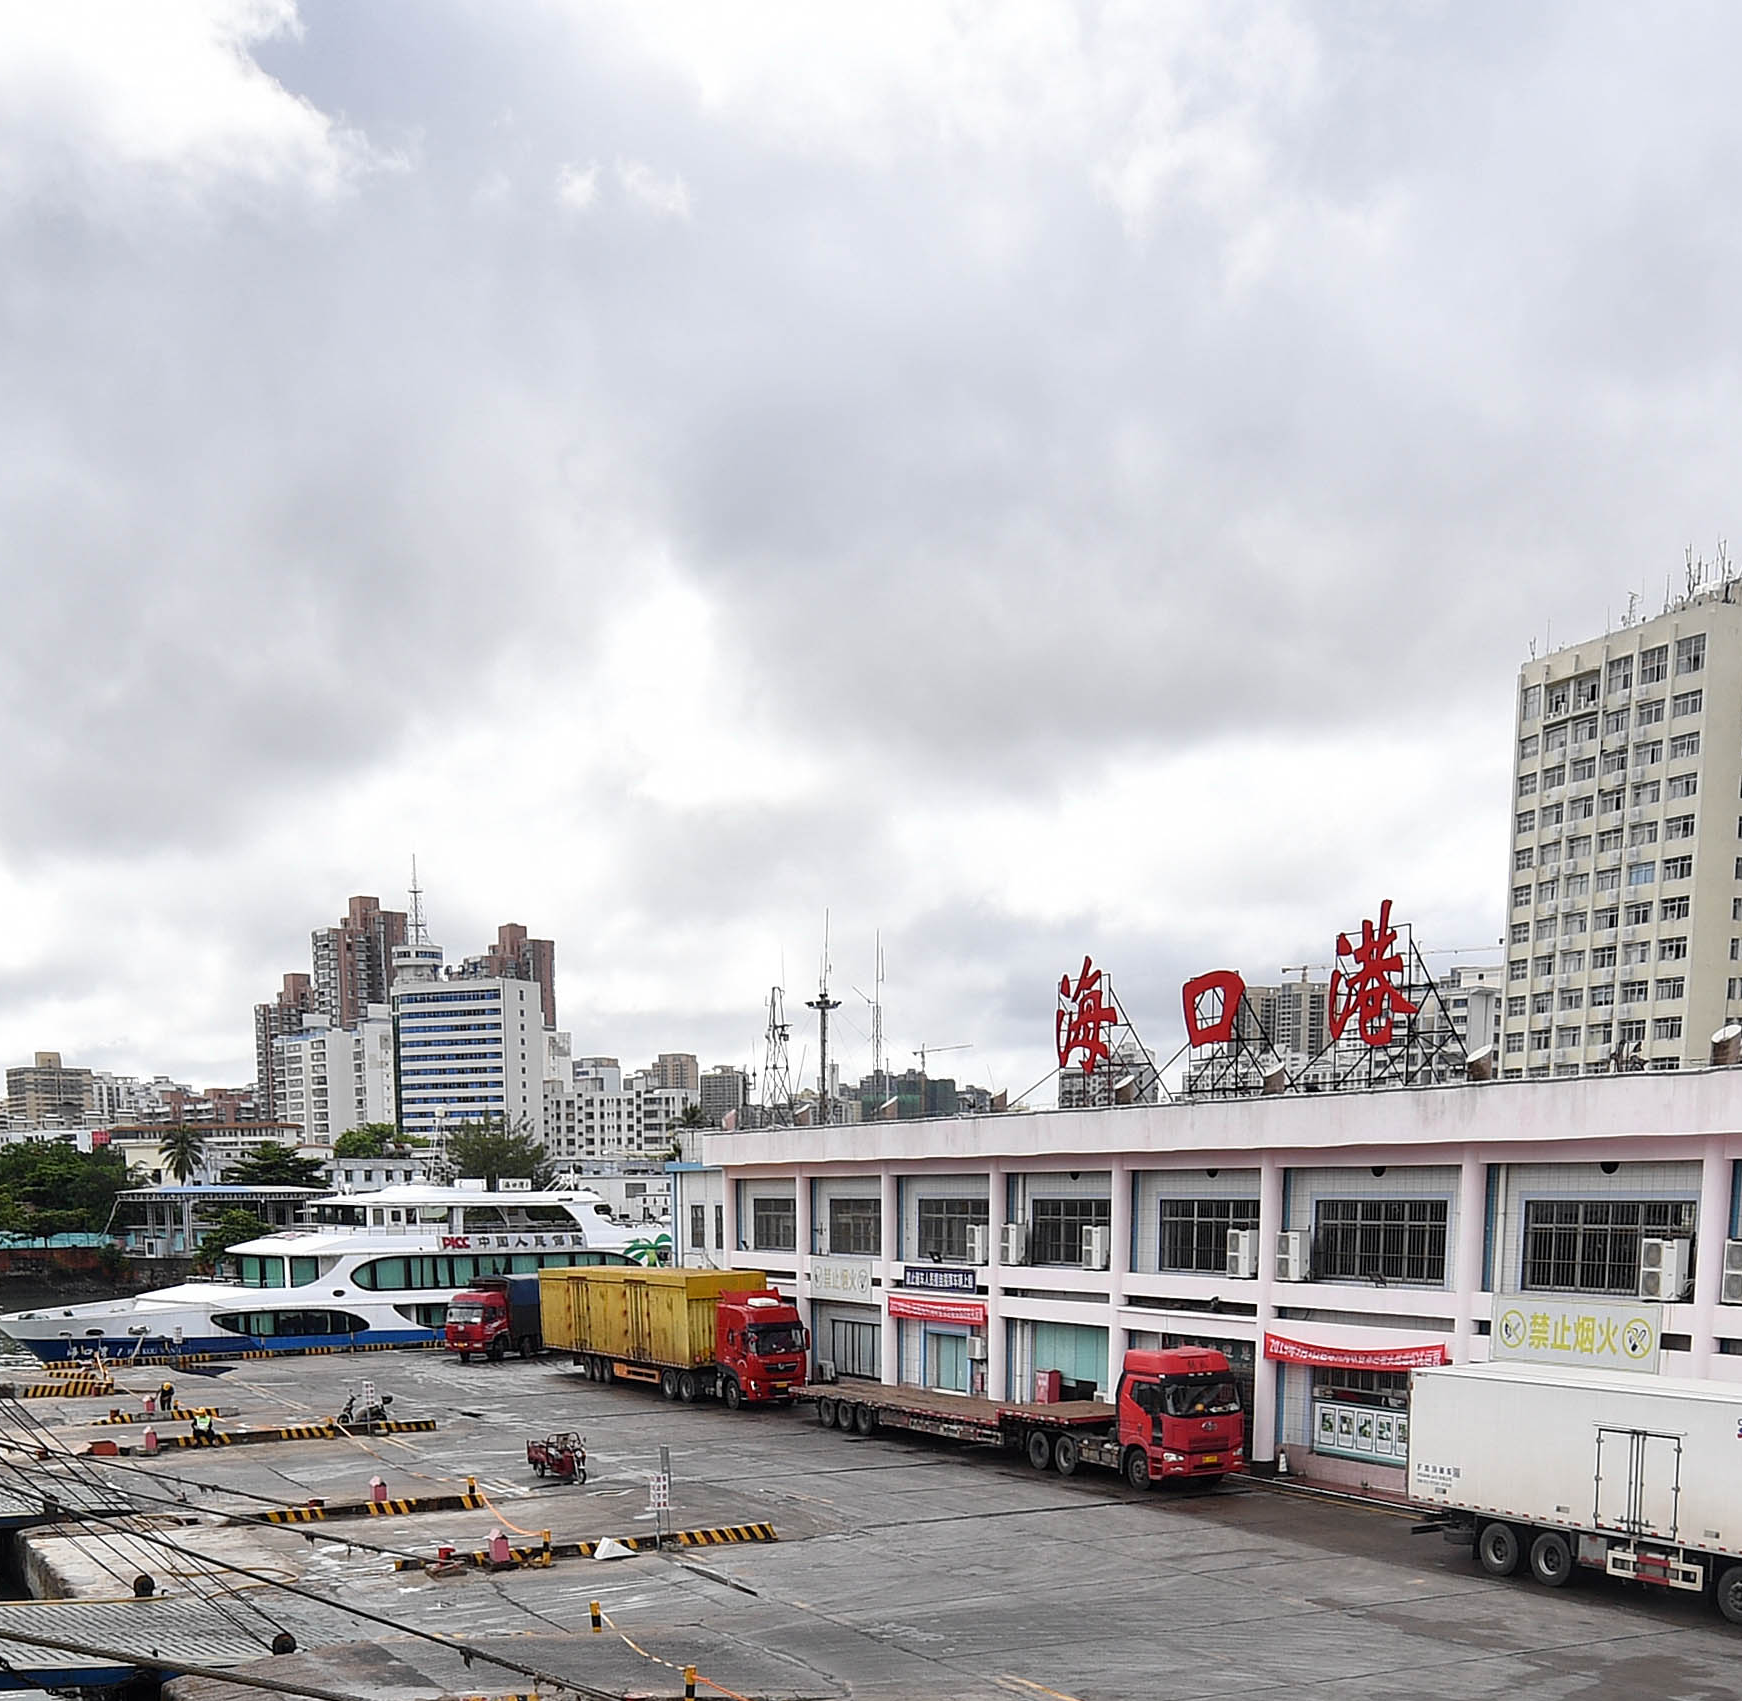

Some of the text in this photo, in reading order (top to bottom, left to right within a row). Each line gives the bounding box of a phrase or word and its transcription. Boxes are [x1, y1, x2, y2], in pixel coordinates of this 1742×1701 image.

[1055, 899, 1419, 1074] 海口港
[441, 1236, 583, 1249] PICC 中国人民保险
[1528, 1312, 1618, 1354] 禁止烟火
